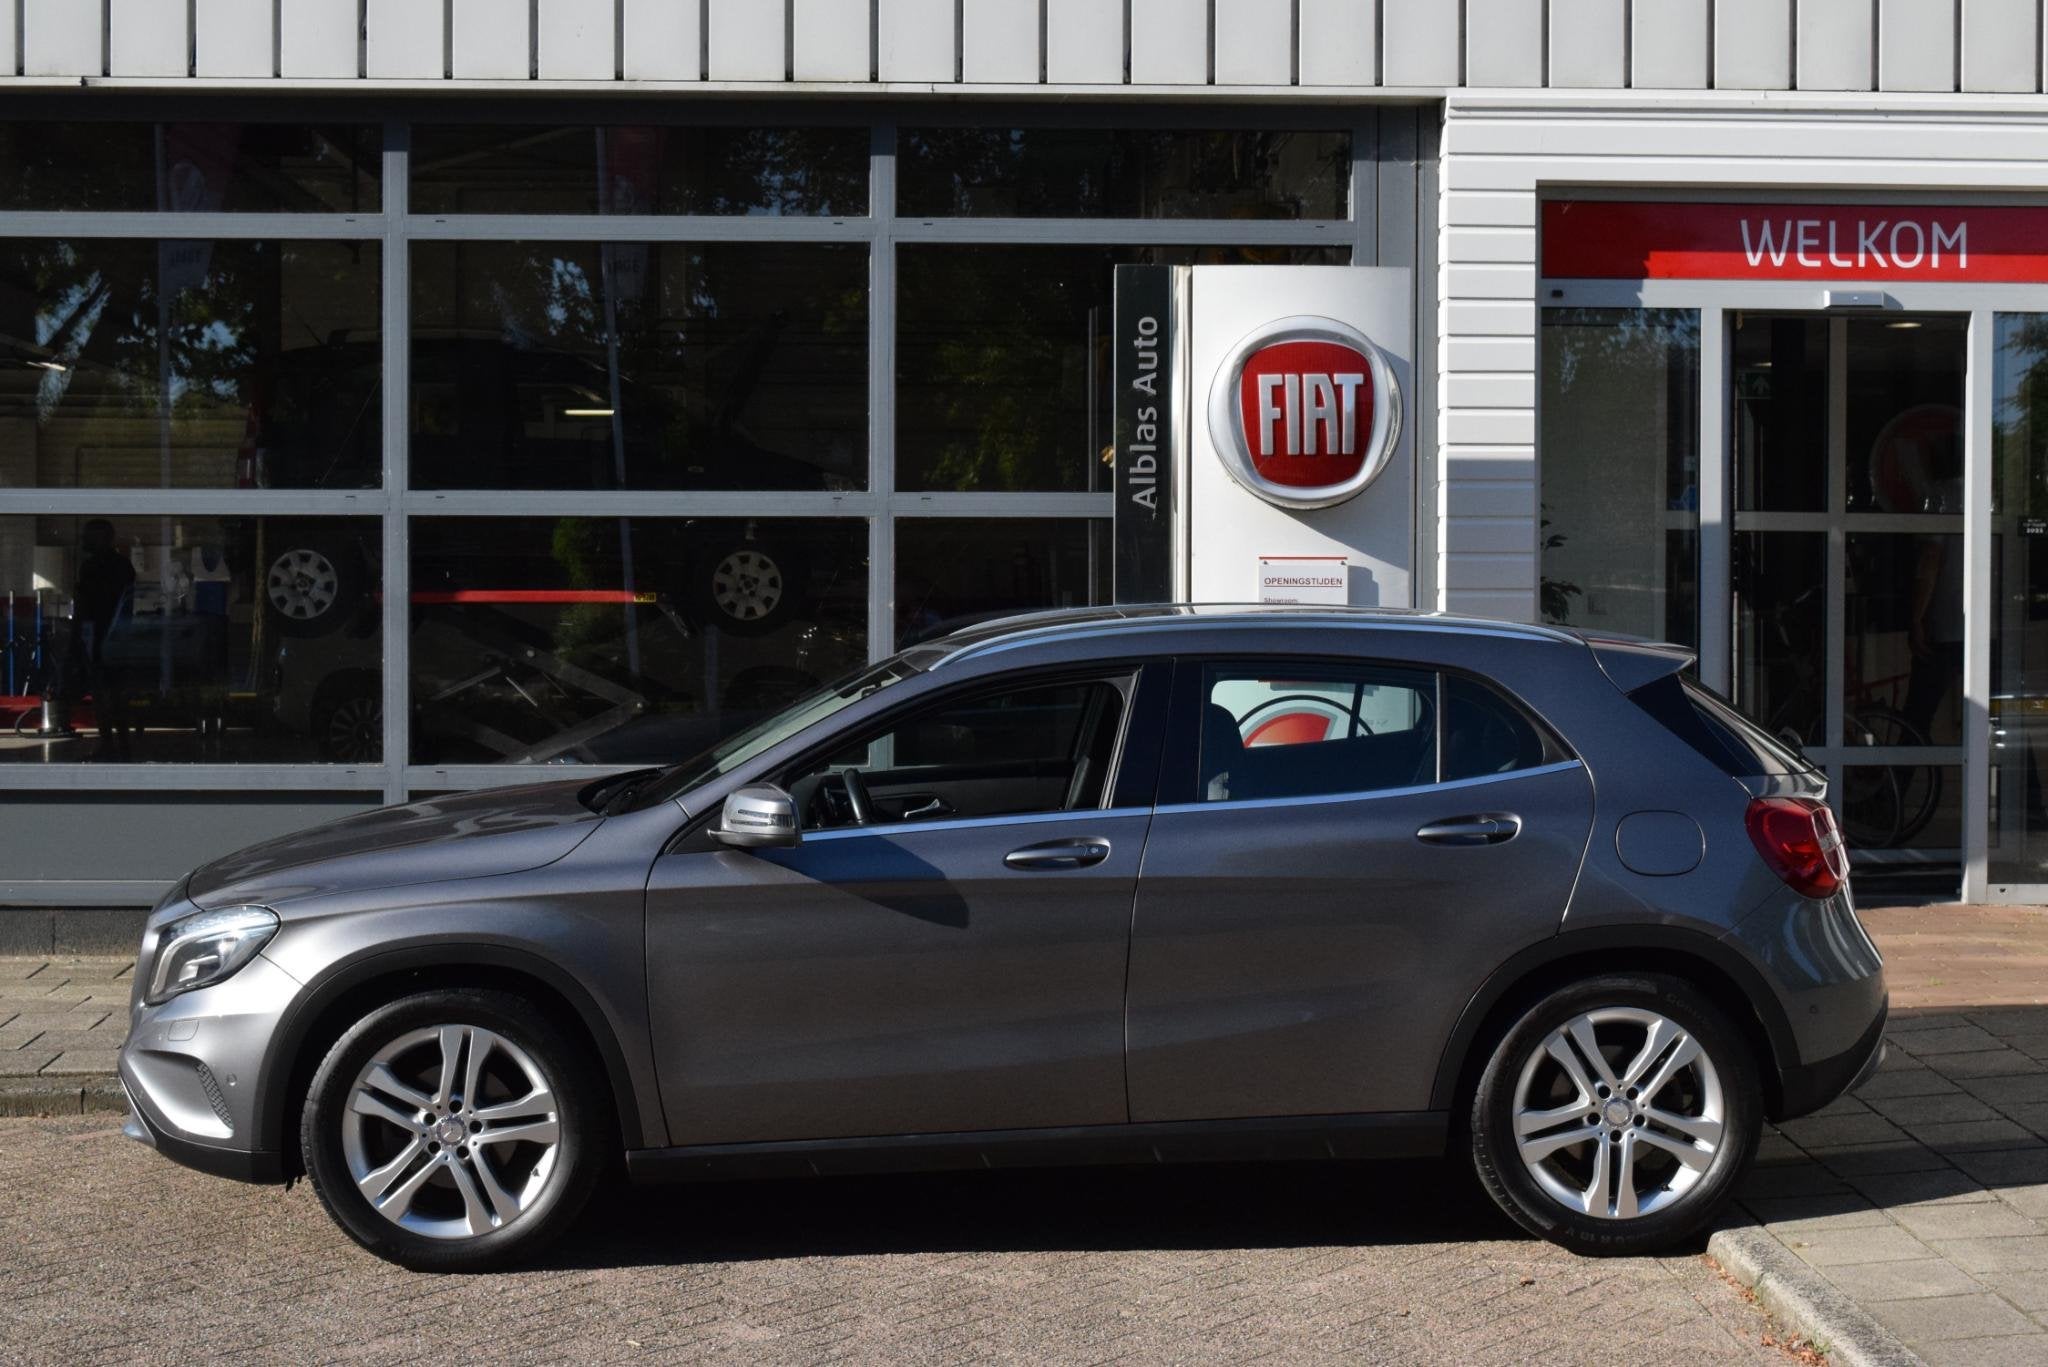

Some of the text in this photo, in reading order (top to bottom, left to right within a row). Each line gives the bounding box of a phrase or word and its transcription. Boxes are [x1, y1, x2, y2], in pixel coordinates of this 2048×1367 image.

[1740, 219, 1967, 269] WELKOM
[1129, 316, 1158, 510] Alblas Auto
[1257, 373, 1364, 456] FIAT
[1264, 577, 1343, 586] OPENINGSTIJDEN
